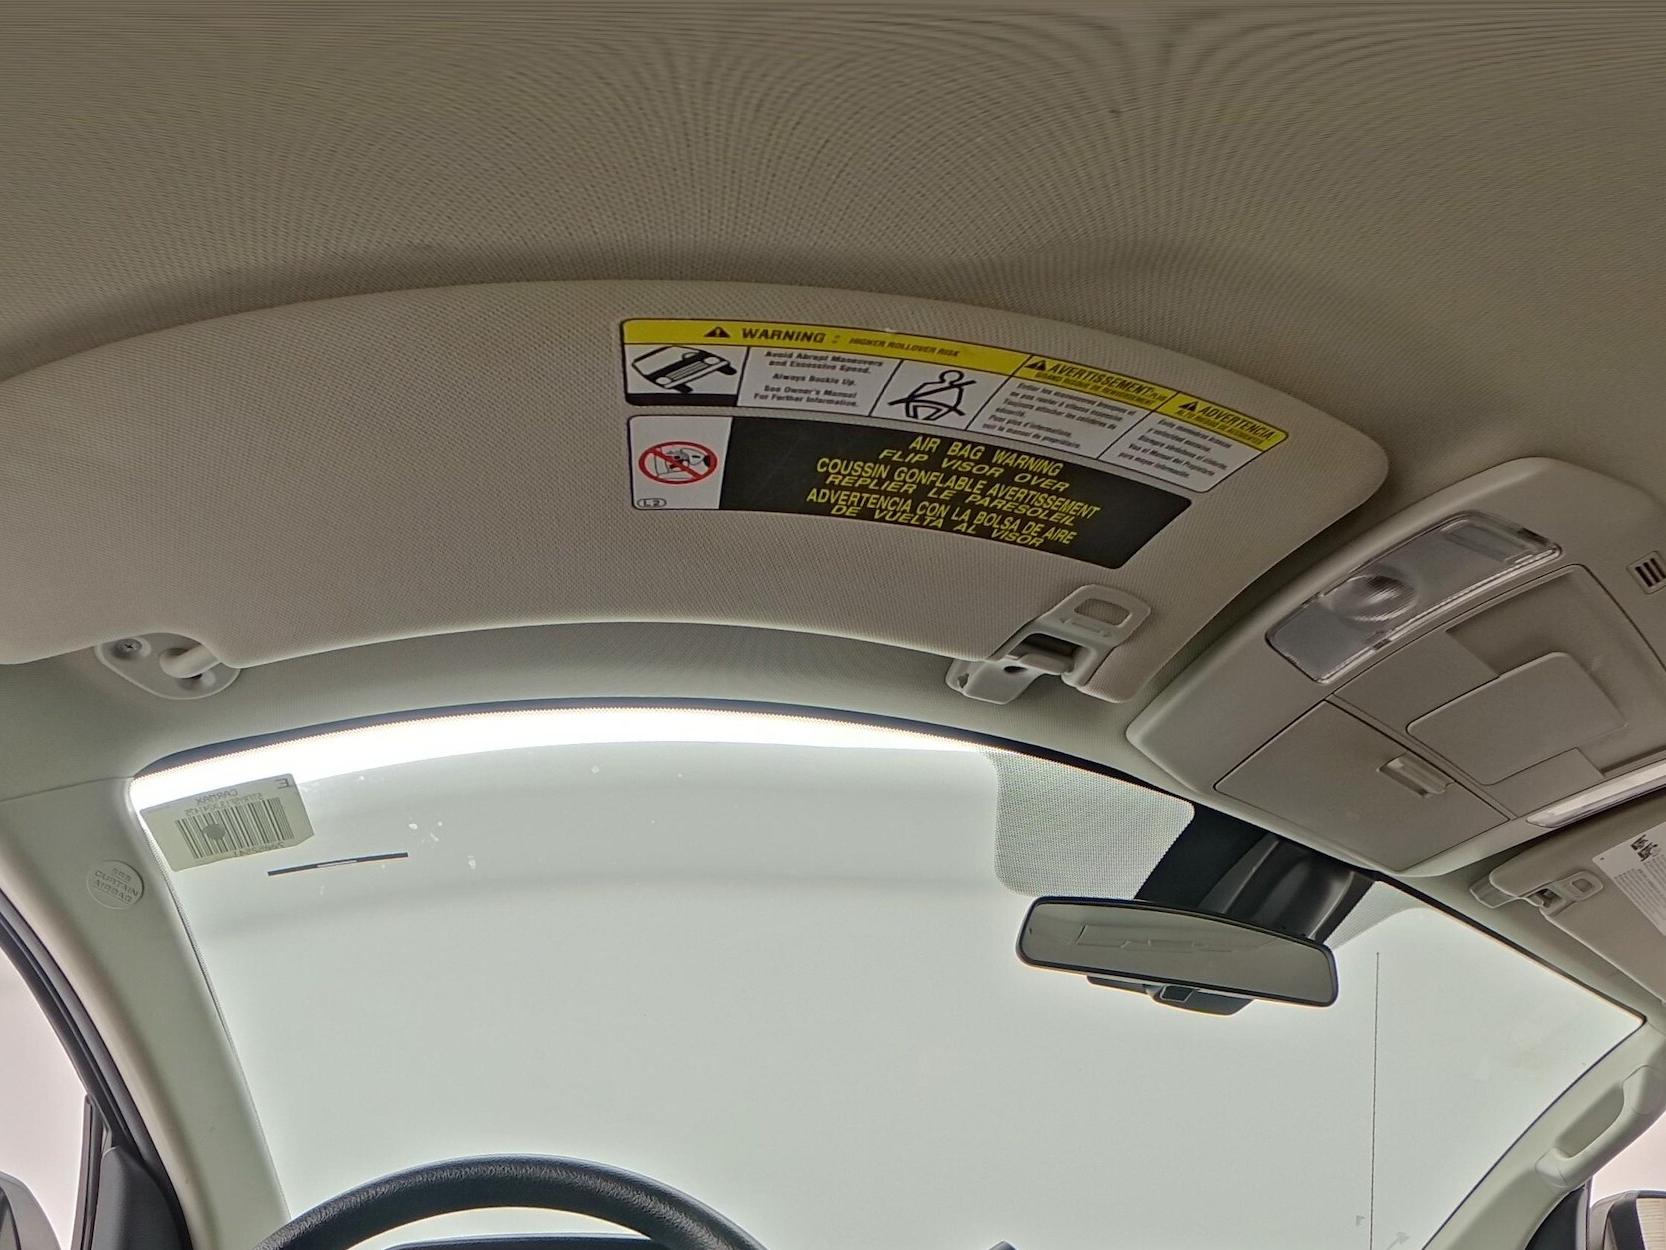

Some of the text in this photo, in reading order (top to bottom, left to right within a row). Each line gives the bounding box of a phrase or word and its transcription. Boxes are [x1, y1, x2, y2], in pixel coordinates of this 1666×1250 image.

[742, 328, 826, 343] WARNING
[878, 449, 1071, 493] FLIP VISOR OVER
[908, 435, 1064, 477] AIR BAG WARNING
[816, 457, 1102, 521] COUSSIN GONFLABLE AVERTISSEMENT
[825, 474, 1077, 527] REPLIER LE PARESOLEIL
[805, 487, 1078, 545] ADVERTENCIA CON LA BOLSA DE AIRE
[830, 504, 1045, 548] DE VUELTA AL VISOR
